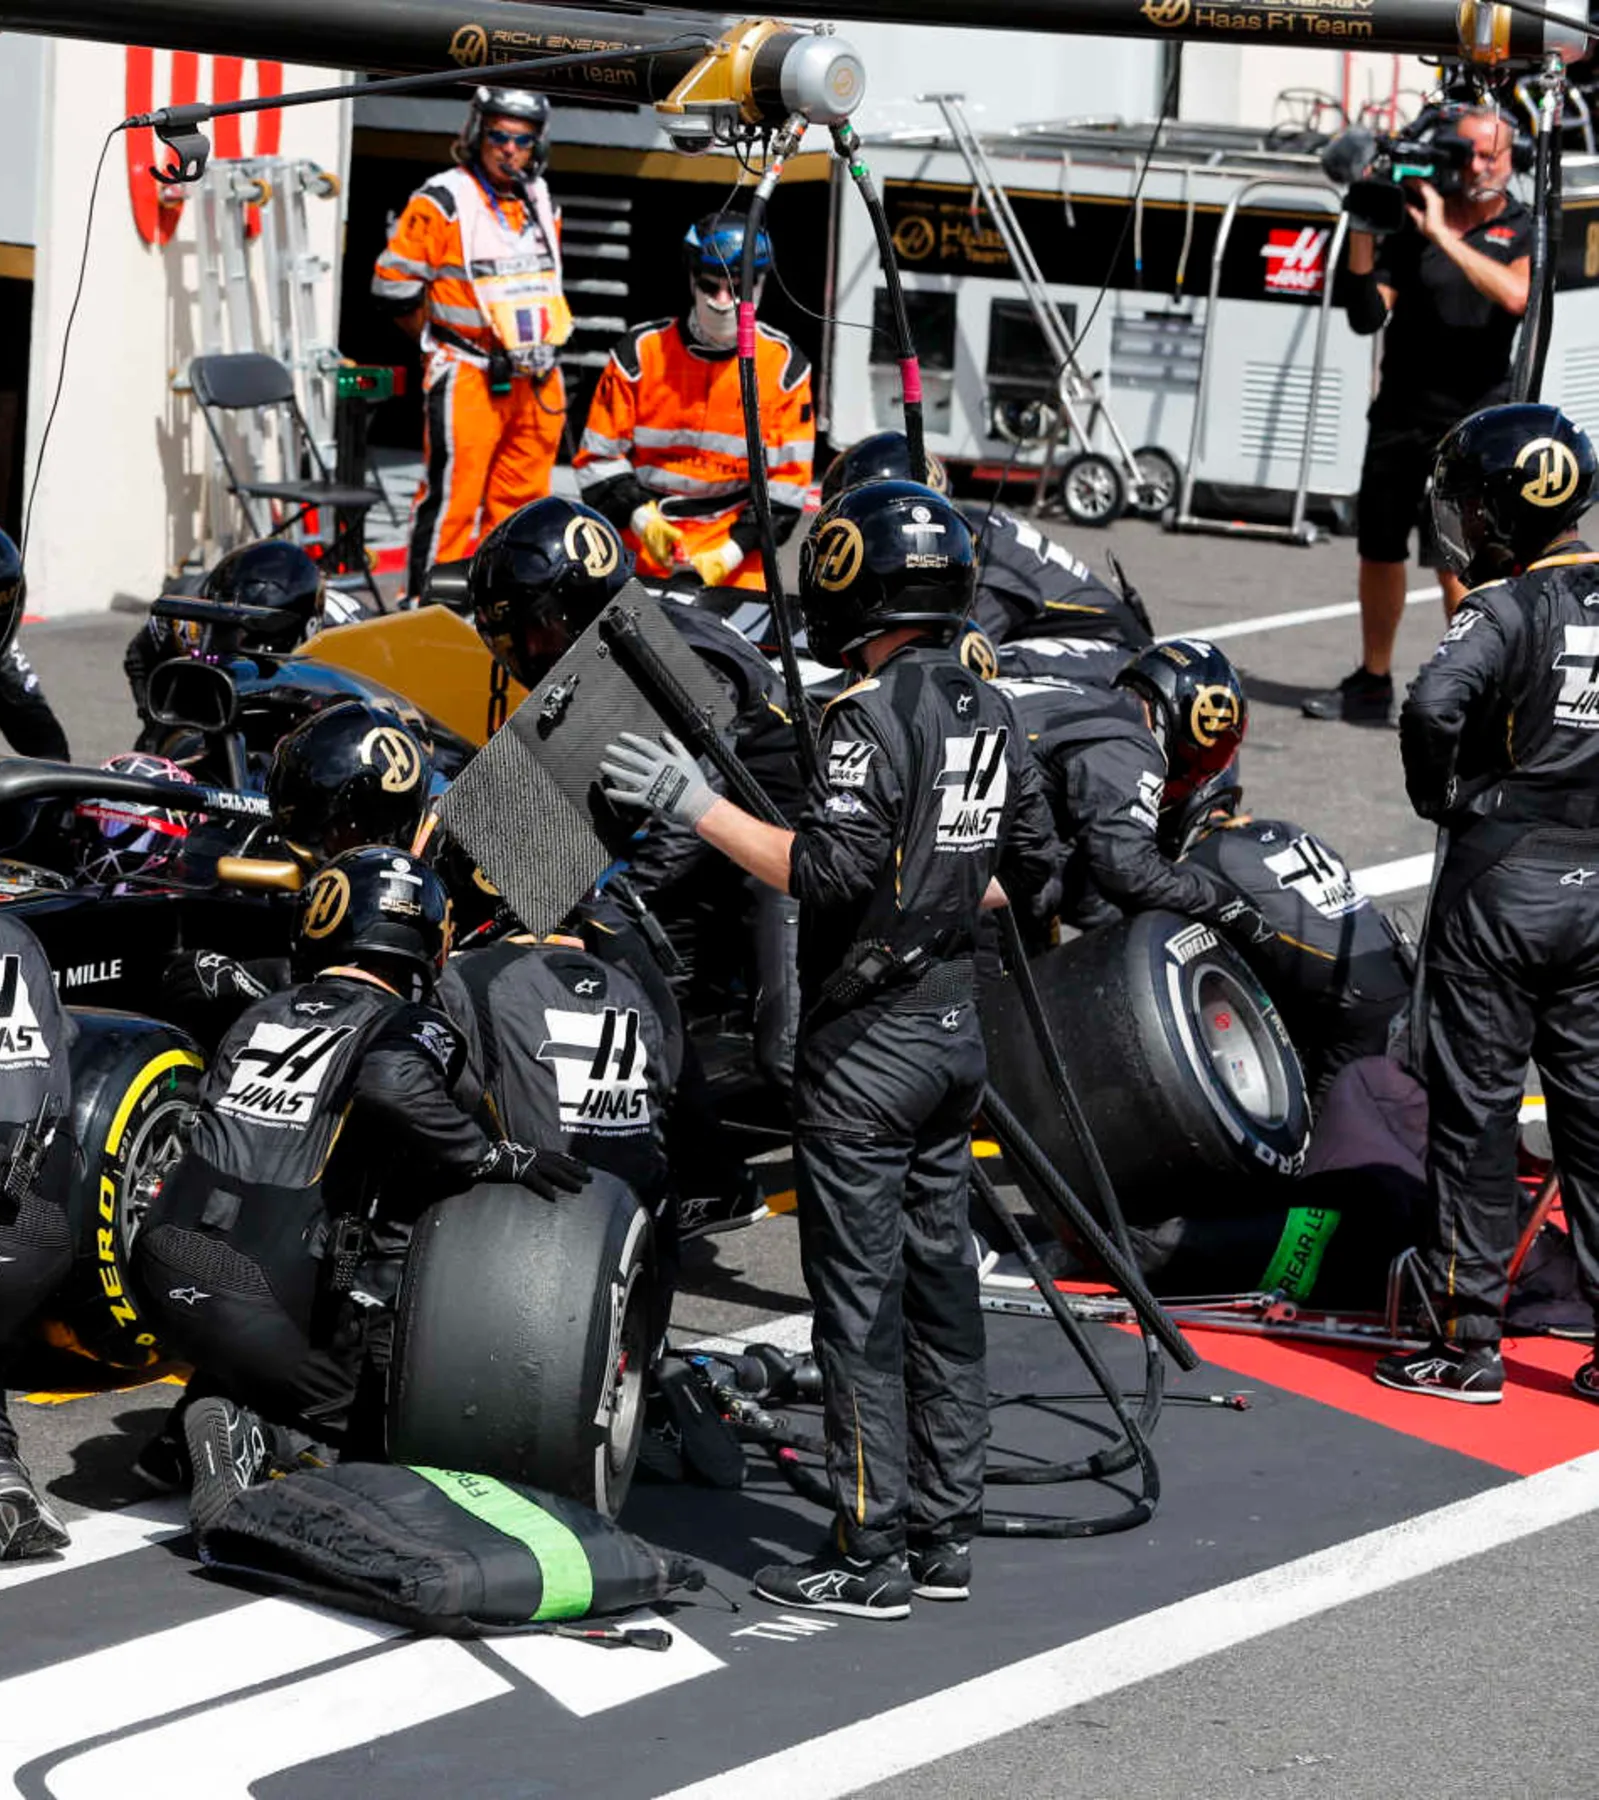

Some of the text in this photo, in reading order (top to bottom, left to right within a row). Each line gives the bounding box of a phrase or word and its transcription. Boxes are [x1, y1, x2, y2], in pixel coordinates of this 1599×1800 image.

[491, 29, 542, 45] RICH
[1194, 9, 1373, 36] Haas F1 Team
[938, 806, 1004, 838] HAAS
[65, 959, 123, 988] MILLE
[227, 1083, 318, 1114] HAAS
[560, 1088, 648, 1120] HAAS
[97, 1174, 137, 1328] ZERO
[729, 1615, 839, 1642] TM
